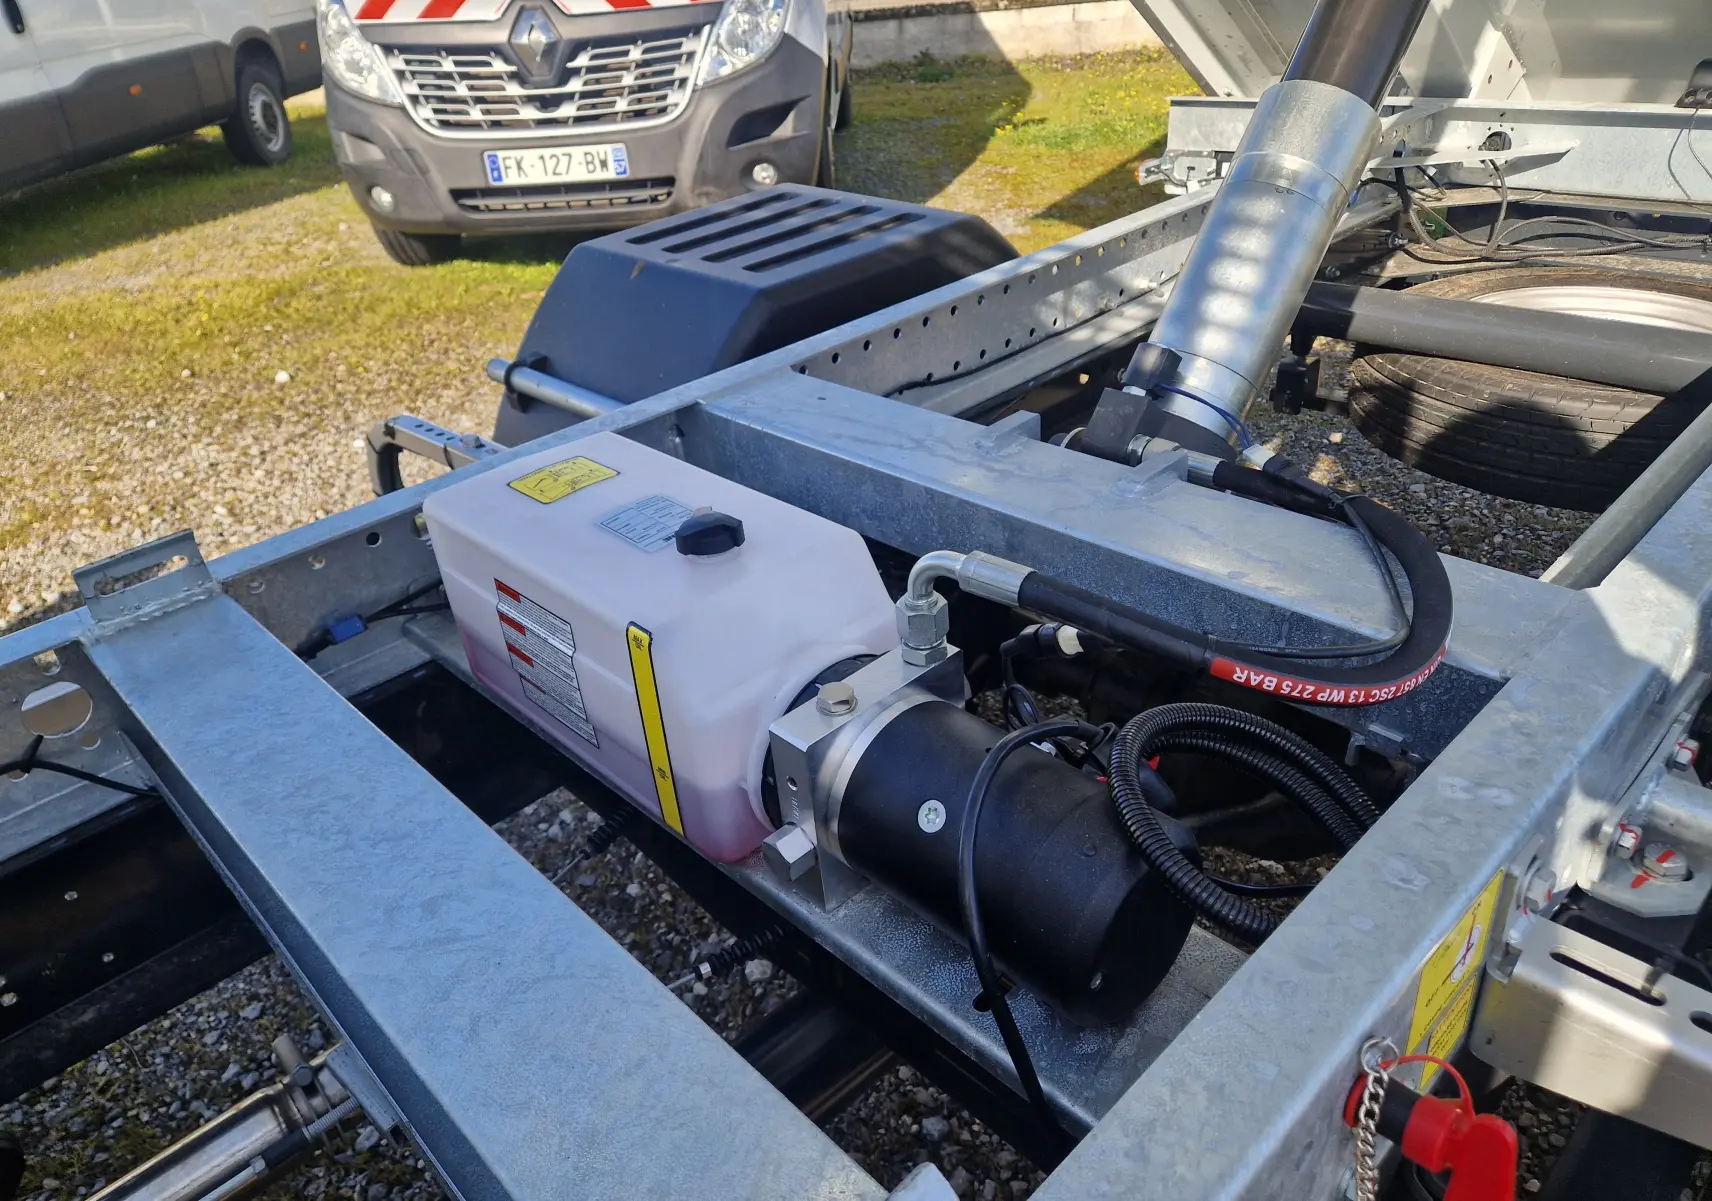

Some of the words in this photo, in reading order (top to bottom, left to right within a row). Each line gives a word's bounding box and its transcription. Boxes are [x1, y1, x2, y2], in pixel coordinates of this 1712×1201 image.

[1232, 667, 1278, 691] BAR
[1416, 669, 1429, 687] EN
[1280, 681, 1315, 699] 275
[1317, 688, 1345, 703] WP
[1348, 690, 1366, 703] 13
[1369, 686, 1396, 701] 2SC
[1396, 678, 1416, 697] 857
